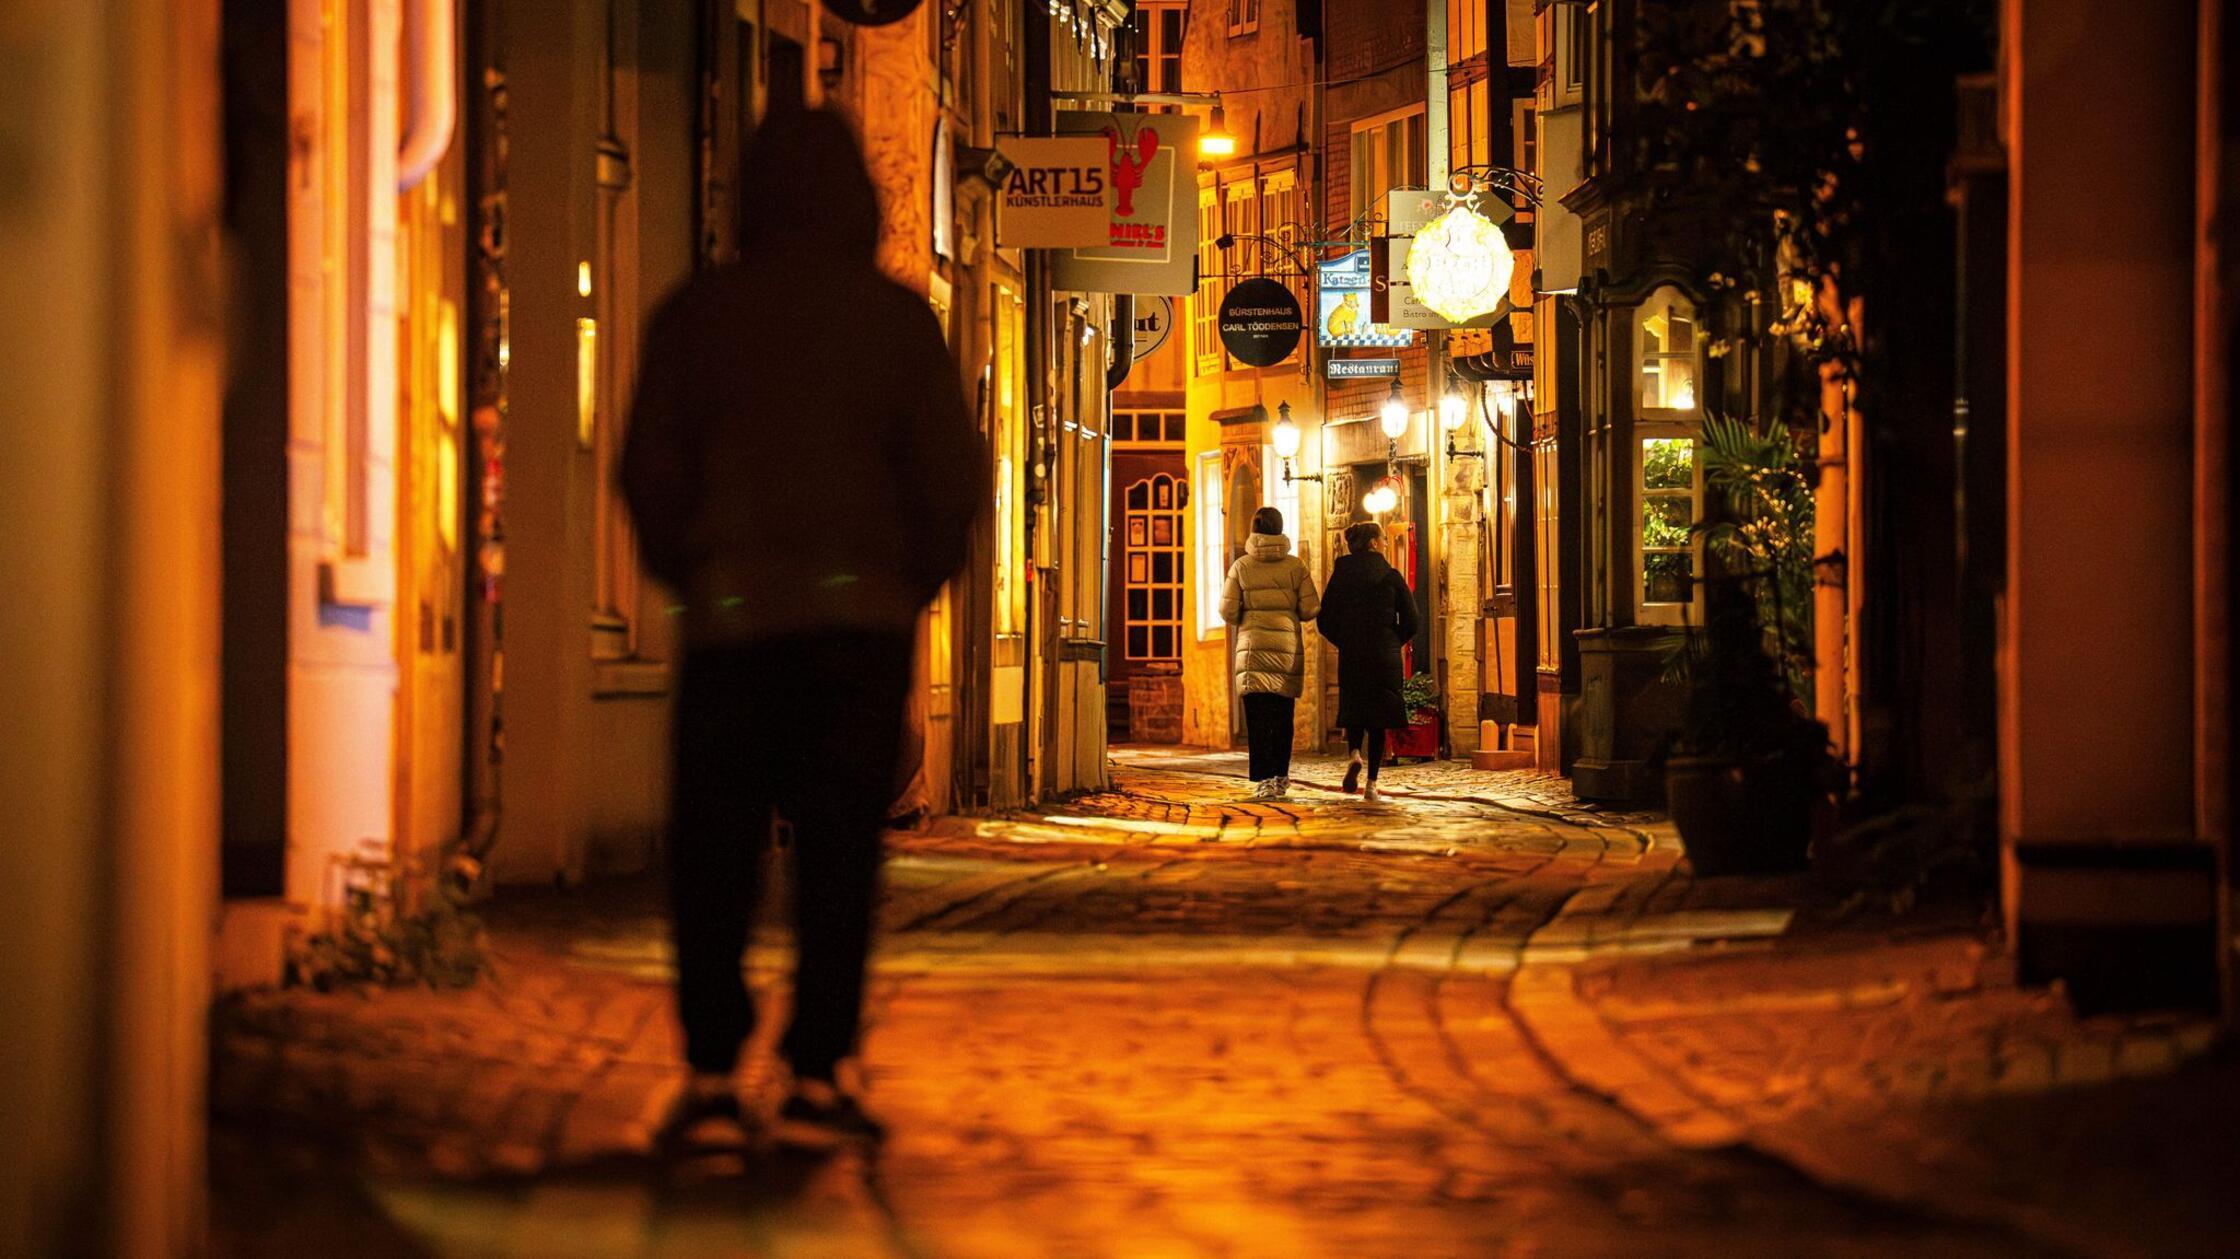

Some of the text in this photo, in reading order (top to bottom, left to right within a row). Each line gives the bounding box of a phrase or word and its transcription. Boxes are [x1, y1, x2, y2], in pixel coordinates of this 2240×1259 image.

[1006, 195, 1104, 208] KÜNSTLERHAUS
[1109, 223, 1165, 241] NIEL'S
[1229, 307, 1293, 317] BÜRSTENHAUS
[1222, 321, 1299, 332] CARL TÖDDENSEN
[1328, 362, 1399, 375] Restaurant
